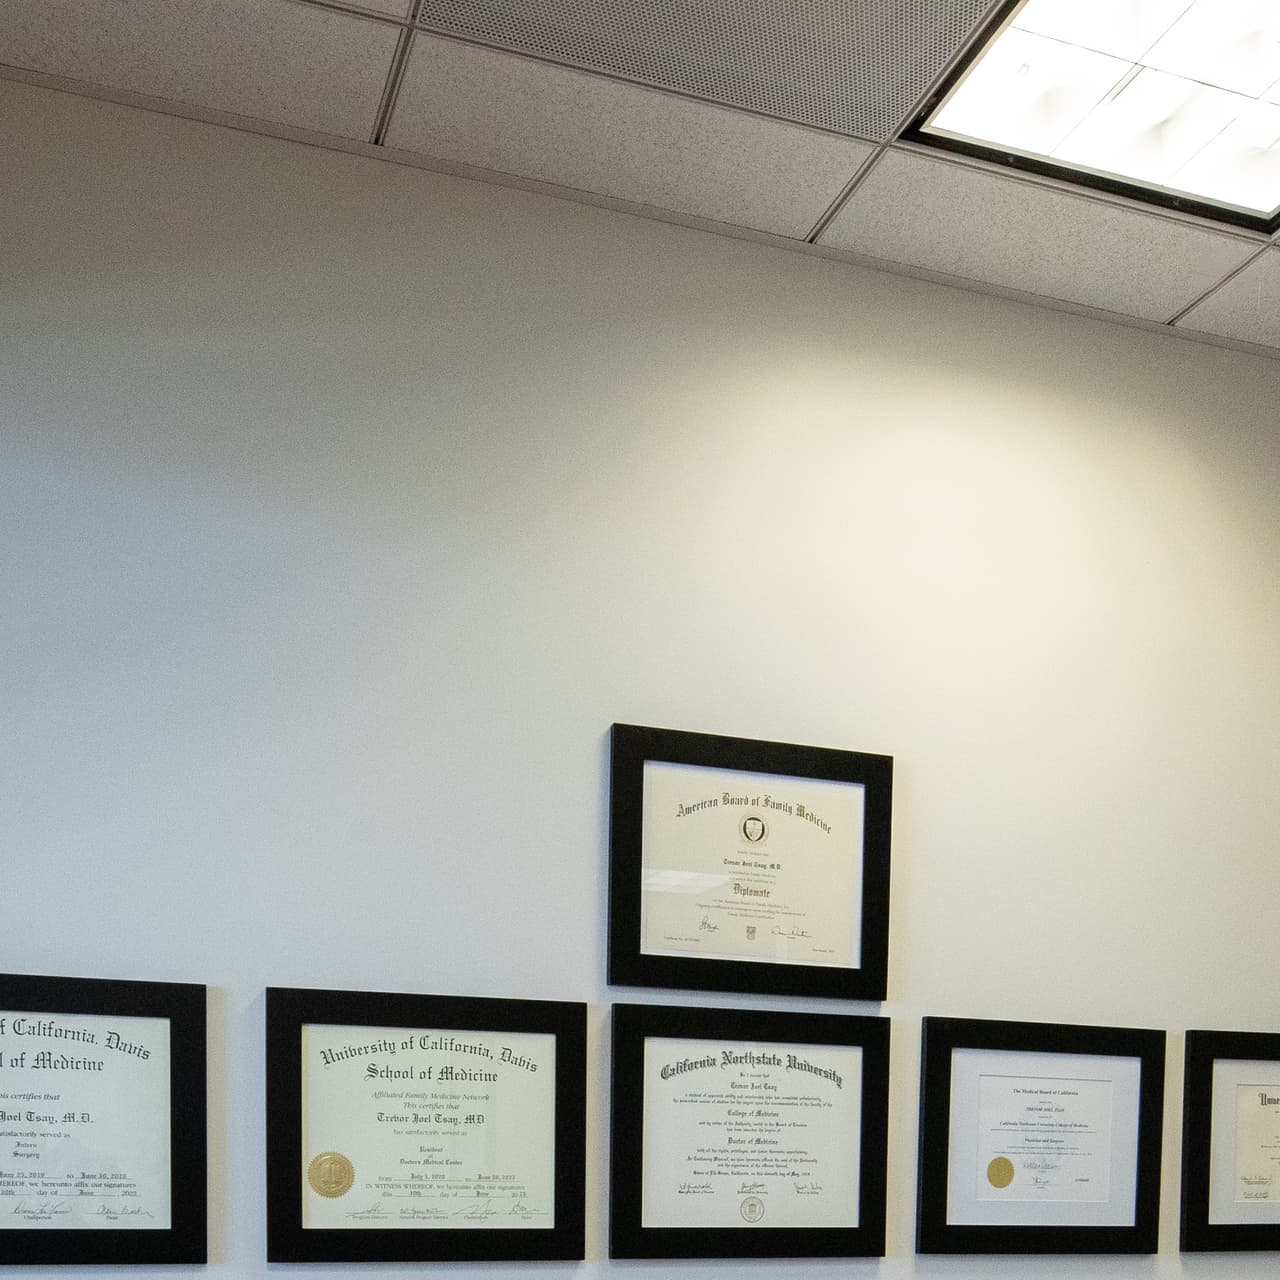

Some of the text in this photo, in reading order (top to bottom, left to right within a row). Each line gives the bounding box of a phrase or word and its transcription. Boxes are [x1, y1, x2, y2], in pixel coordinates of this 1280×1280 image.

[675, 792, 831, 834] American Board of Family Medicine
[733, 882, 770, 898] Diplomate
[104, 1030, 152, 1061] Davis
[320, 1035, 538, 1073] University of California, Davis
[10, 1051, 26, 1069] of
[31, 1051, 104, 1071] Medicine
[660, 1050, 843, 1089] California Northstate University
[364, 1063, 498, 1083] School of Medicine
[10, 1092, 42, 1101] certifies
[43, 1093, 60, 1101] that
[405, 1092, 430, 1100] Family
[25, 1111, 58, 1124] Tsay,
[62, 1112, 94, 1123] M.D.
[377, 1111, 409, 1122] Trevor
[412, 1113, 431, 1123] Joel
[464, 1114, 485, 1124] MD
[747, 1137, 754, 1145] of
